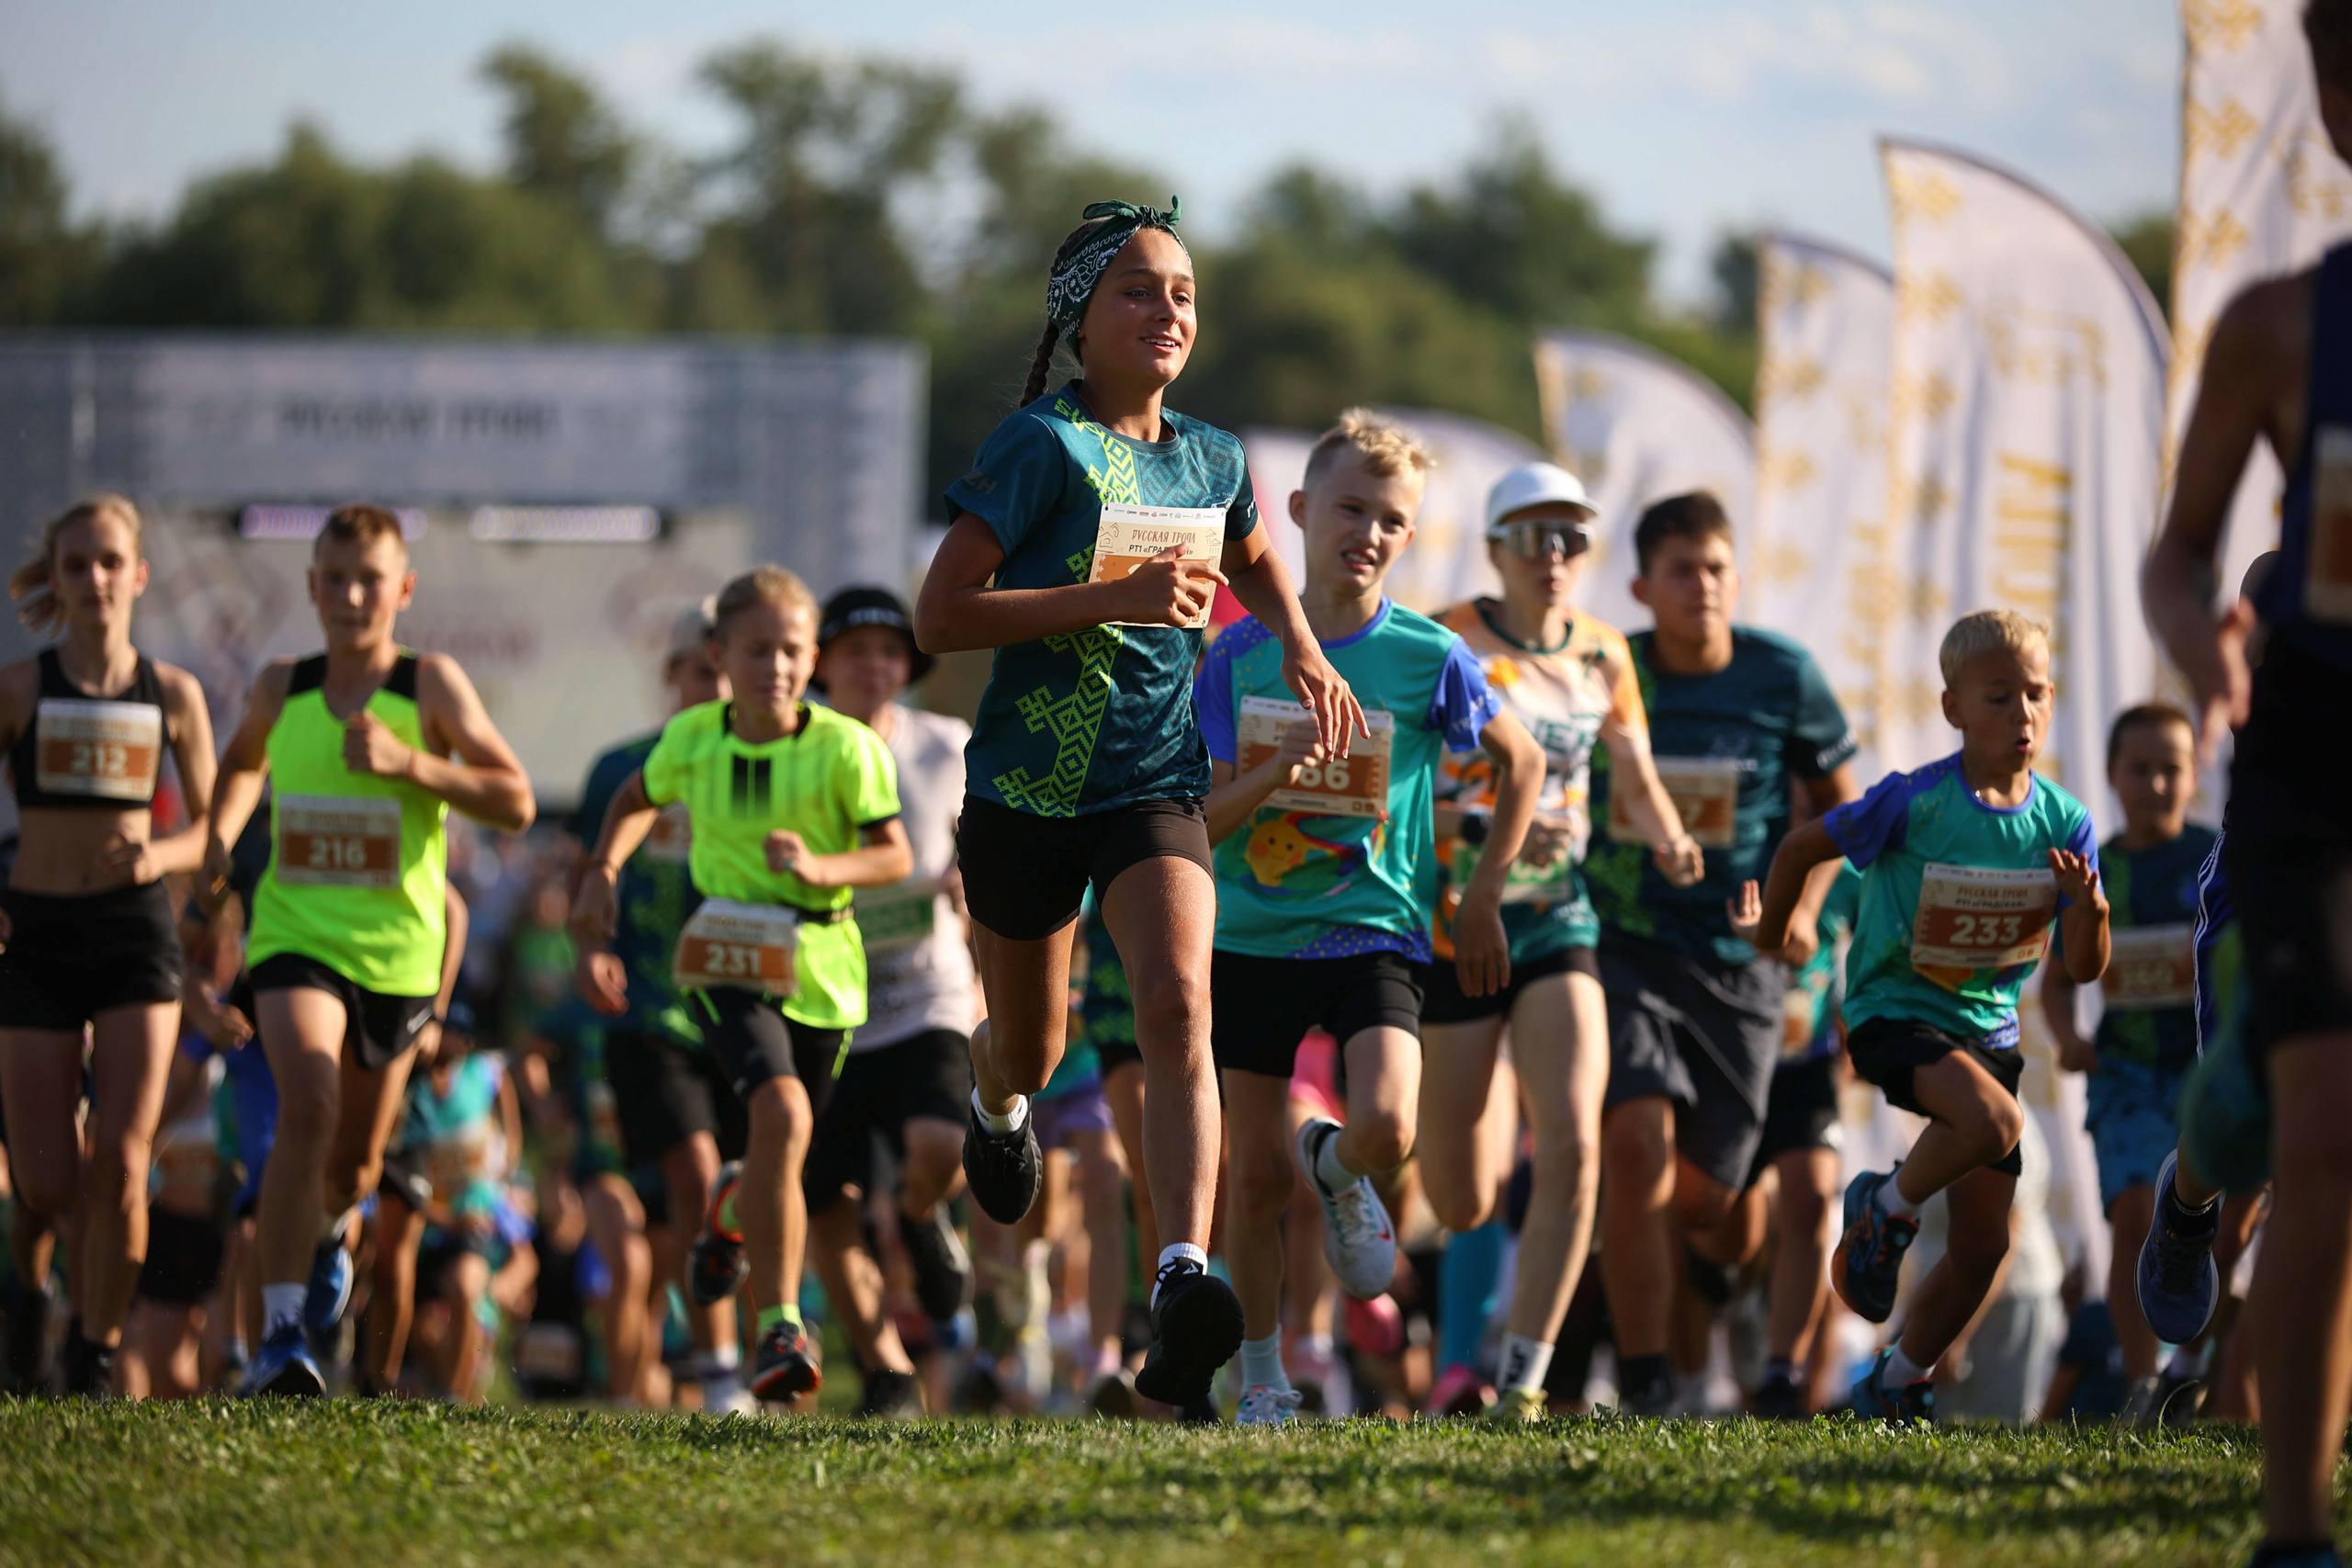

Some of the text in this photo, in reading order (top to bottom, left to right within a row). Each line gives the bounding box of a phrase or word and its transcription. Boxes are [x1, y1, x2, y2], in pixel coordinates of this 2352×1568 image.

[1128, 544, 1143, 553] РТ1
[1132, 529, 1196, 544] РУССКАЯ ТРОПА
[72, 745, 128, 773] 212
[308, 837, 367, 869] 216
[1949, 913, 2024, 947] 233
[704, 942, 761, 977] 231
